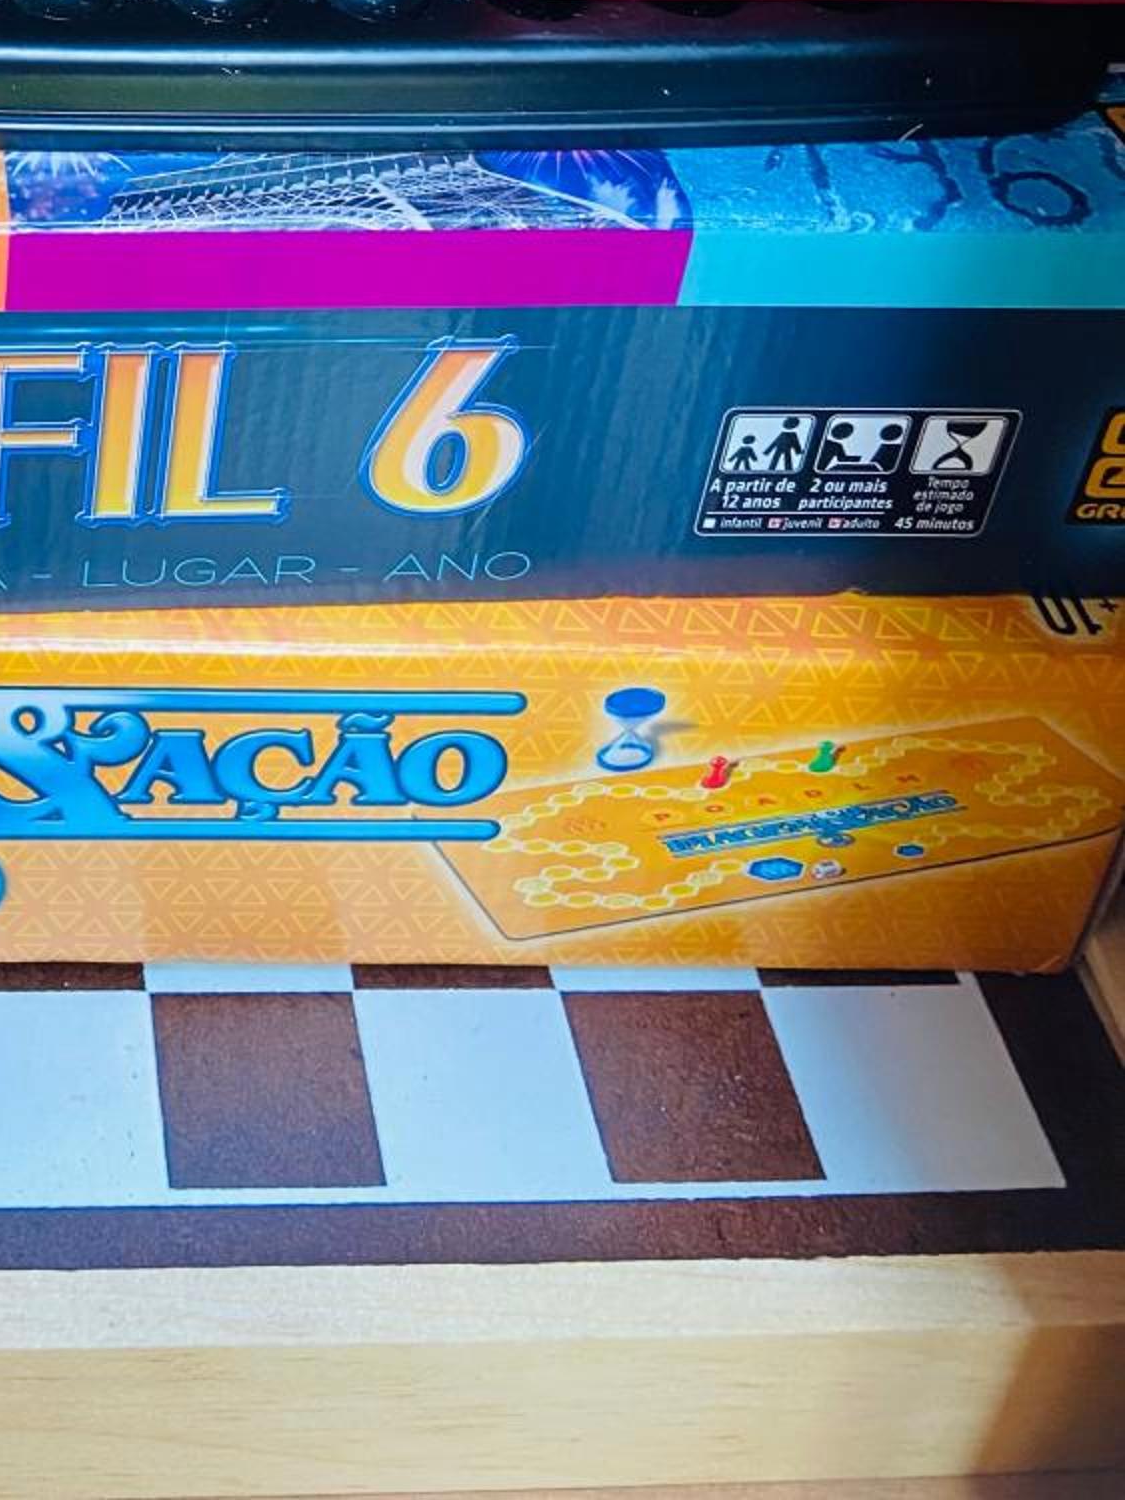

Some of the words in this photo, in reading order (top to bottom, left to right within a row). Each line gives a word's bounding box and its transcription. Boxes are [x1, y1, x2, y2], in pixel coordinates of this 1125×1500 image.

[359, 333, 534, 519] 6
[709, 478, 722, 493] A
[724, 478, 772, 496] partir
[775, 478, 796, 493] de
[809, 478, 822, 493] 2
[824, 480, 845, 493] ou
[848, 477, 888, 493] mais
[927, 476, 971, 491] Tempo
[721, 495, 738, 509] 12
[742, 496, 782, 509] anos
[913, 488, 975, 501] estimado
[797, 495, 894, 511] participantes
[916, 501, 933, 513] de
[933, 502, 965, 516] jogo
[1075, 502, 1125, 520] GR
[720, 517, 763, 529] infantil
[894, 516, 914, 529] 45
[915, 517, 975, 531] minutos
[82, 554, 317, 590] LUGAR
[383, 550, 531, 582] ANO
[116, 709, 510, 824] AÇÃO
